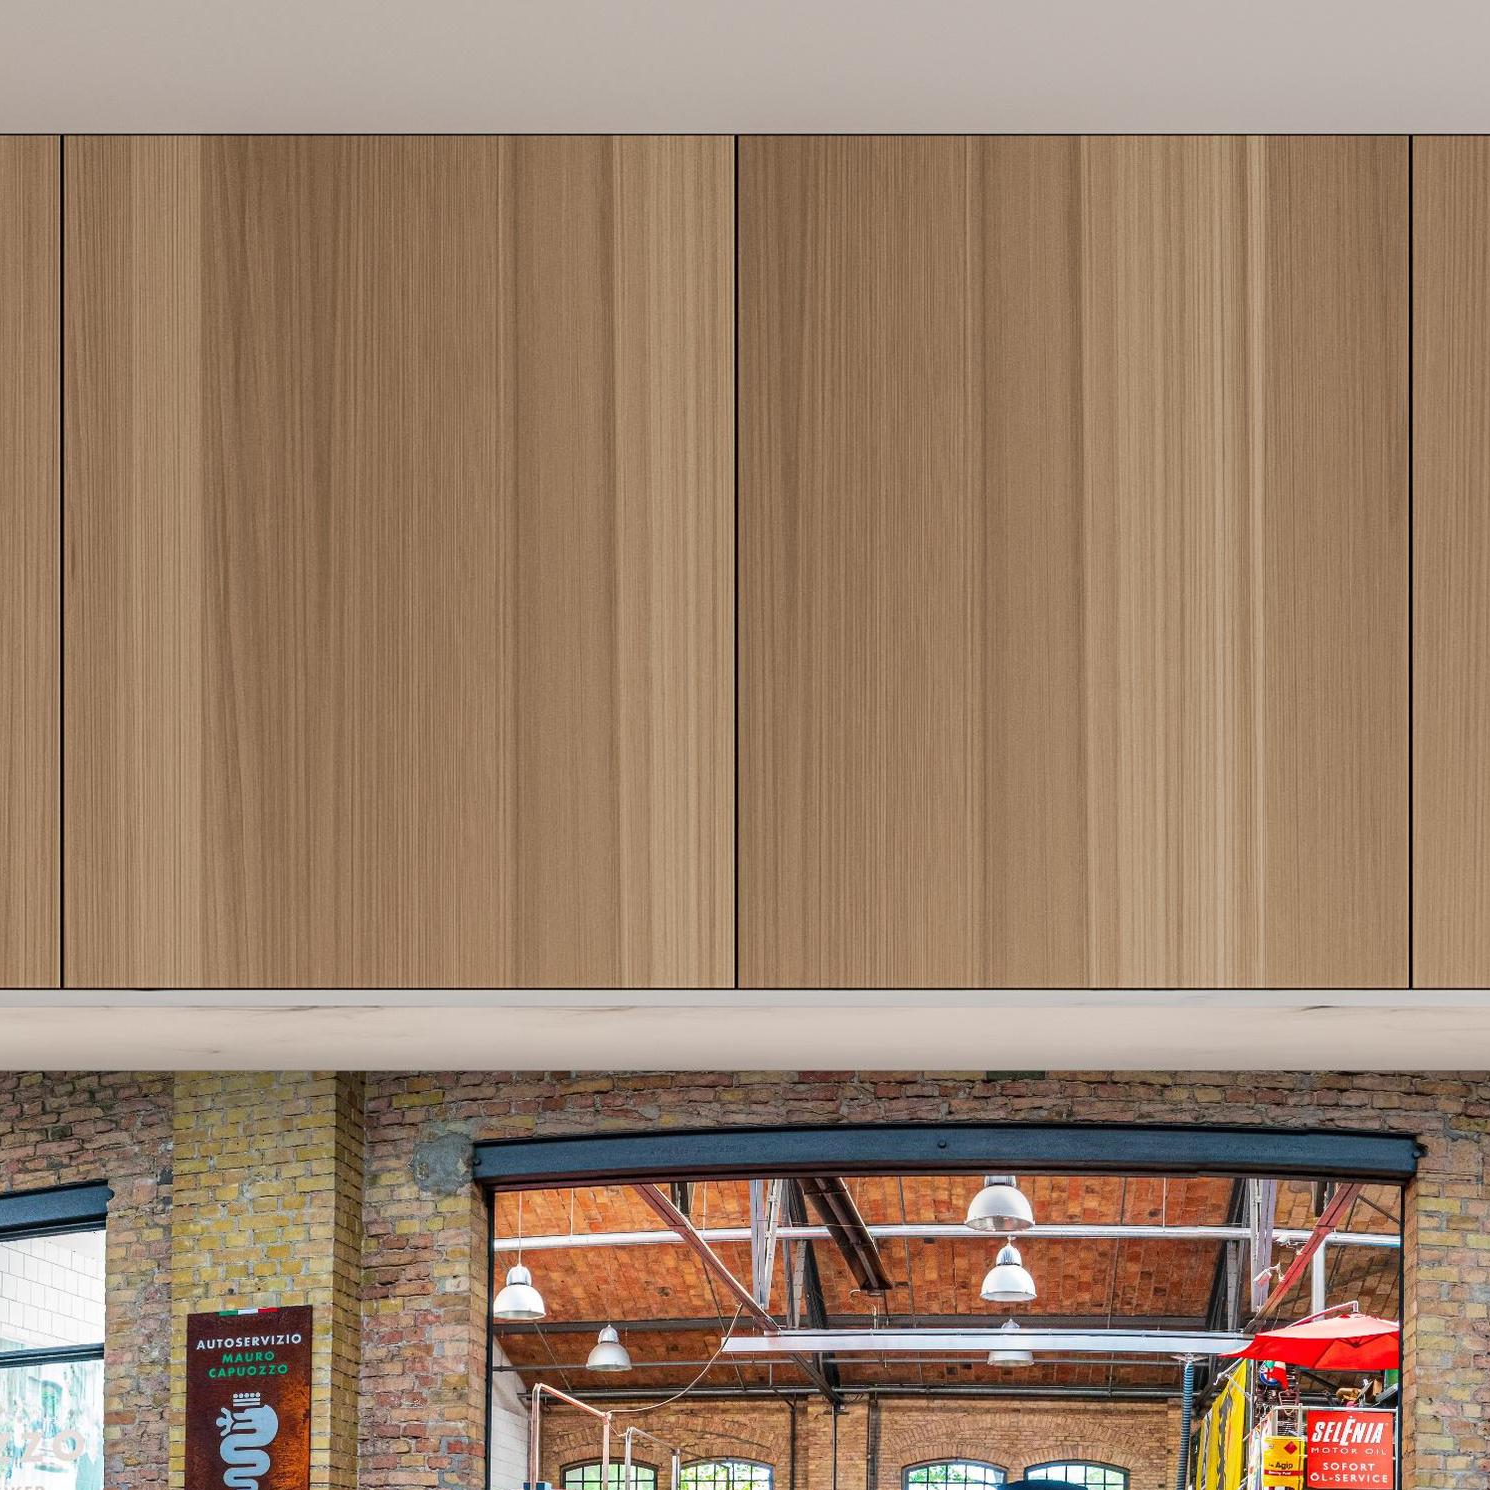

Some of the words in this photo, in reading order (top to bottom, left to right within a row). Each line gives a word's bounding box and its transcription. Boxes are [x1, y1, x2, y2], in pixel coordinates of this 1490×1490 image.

[196, 1333, 302, 1350] AUTOSERVIZIO
[222, 1351, 275, 1364] MAURO
[208, 1364, 289, 1378] CAPUOZZO
[1311, 1447, 1358, 1455] MOTOR
[1365, 1448, 1387, 1456] OIL
[1322, 1462, 1376, 1472] SOFORT
